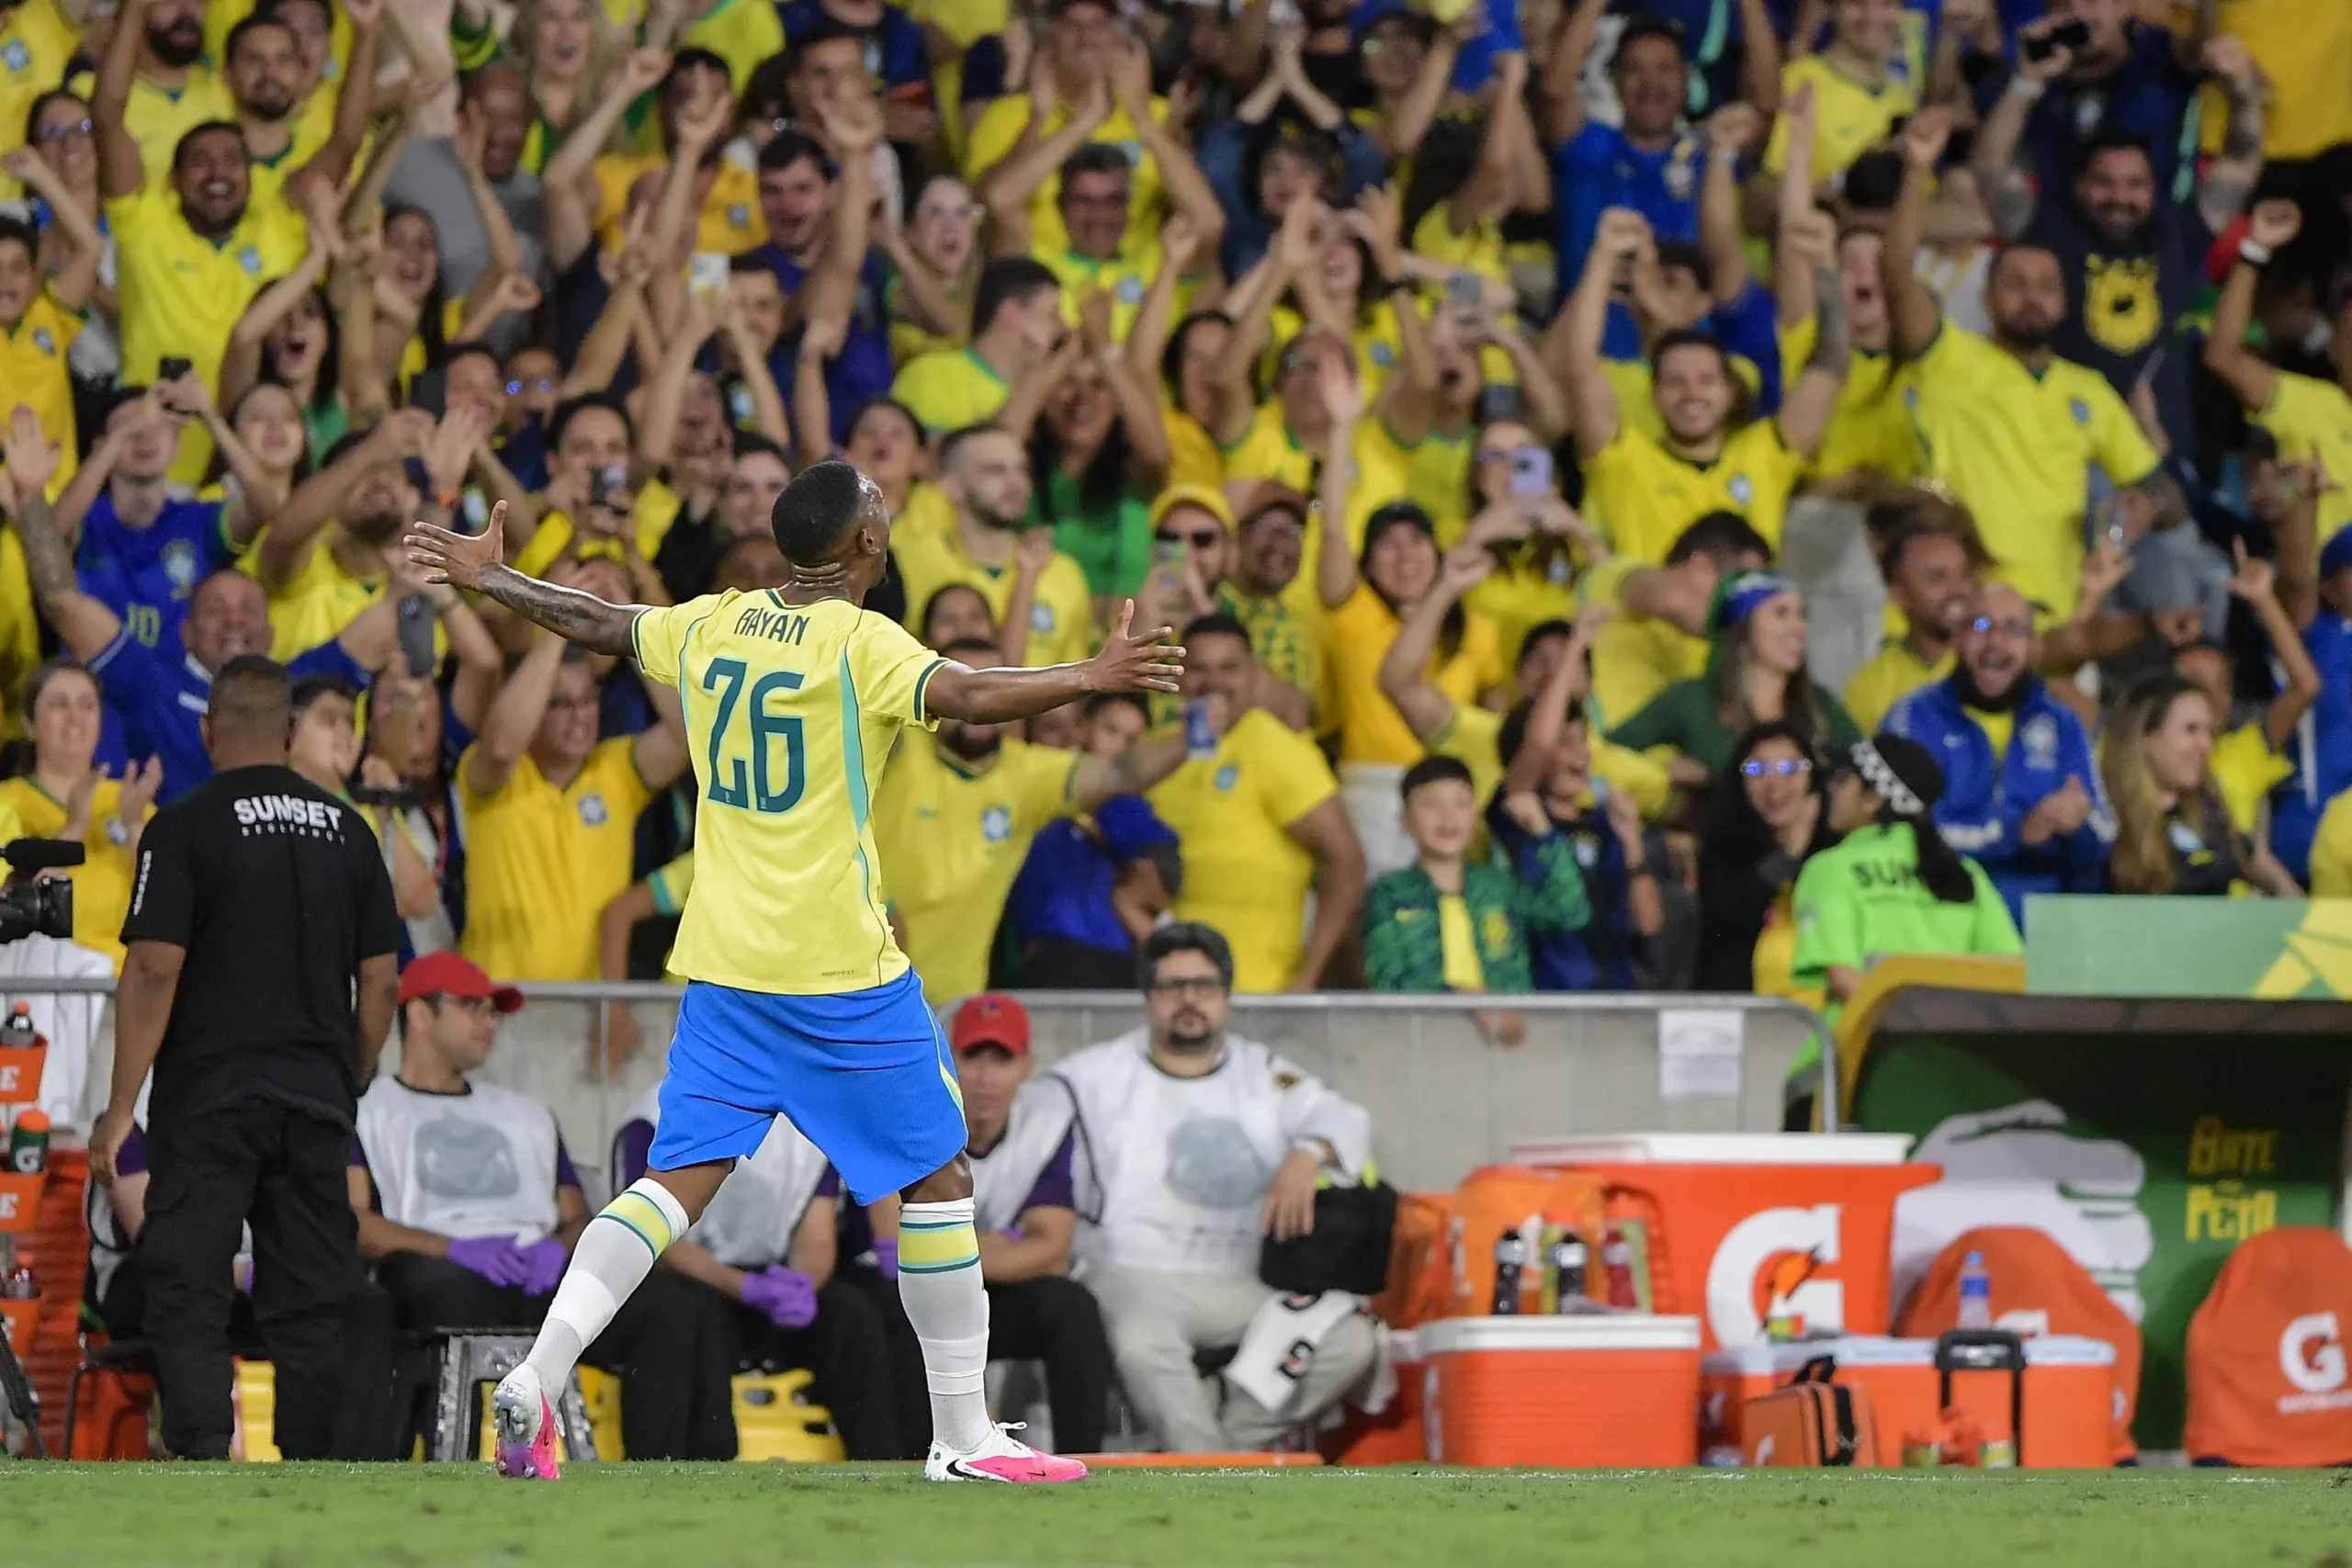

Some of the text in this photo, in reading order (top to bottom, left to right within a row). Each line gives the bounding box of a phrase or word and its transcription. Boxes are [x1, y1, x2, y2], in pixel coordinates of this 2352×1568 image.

[733, 607, 811, 646] RAYAN
[702, 656, 807, 815] 26
[233, 794, 343, 832] SUNSET
[15, 1145, 40, 1174] G
[1706, 1204, 1844, 1350] G
[2280, 1312, 2346, 1392] G
